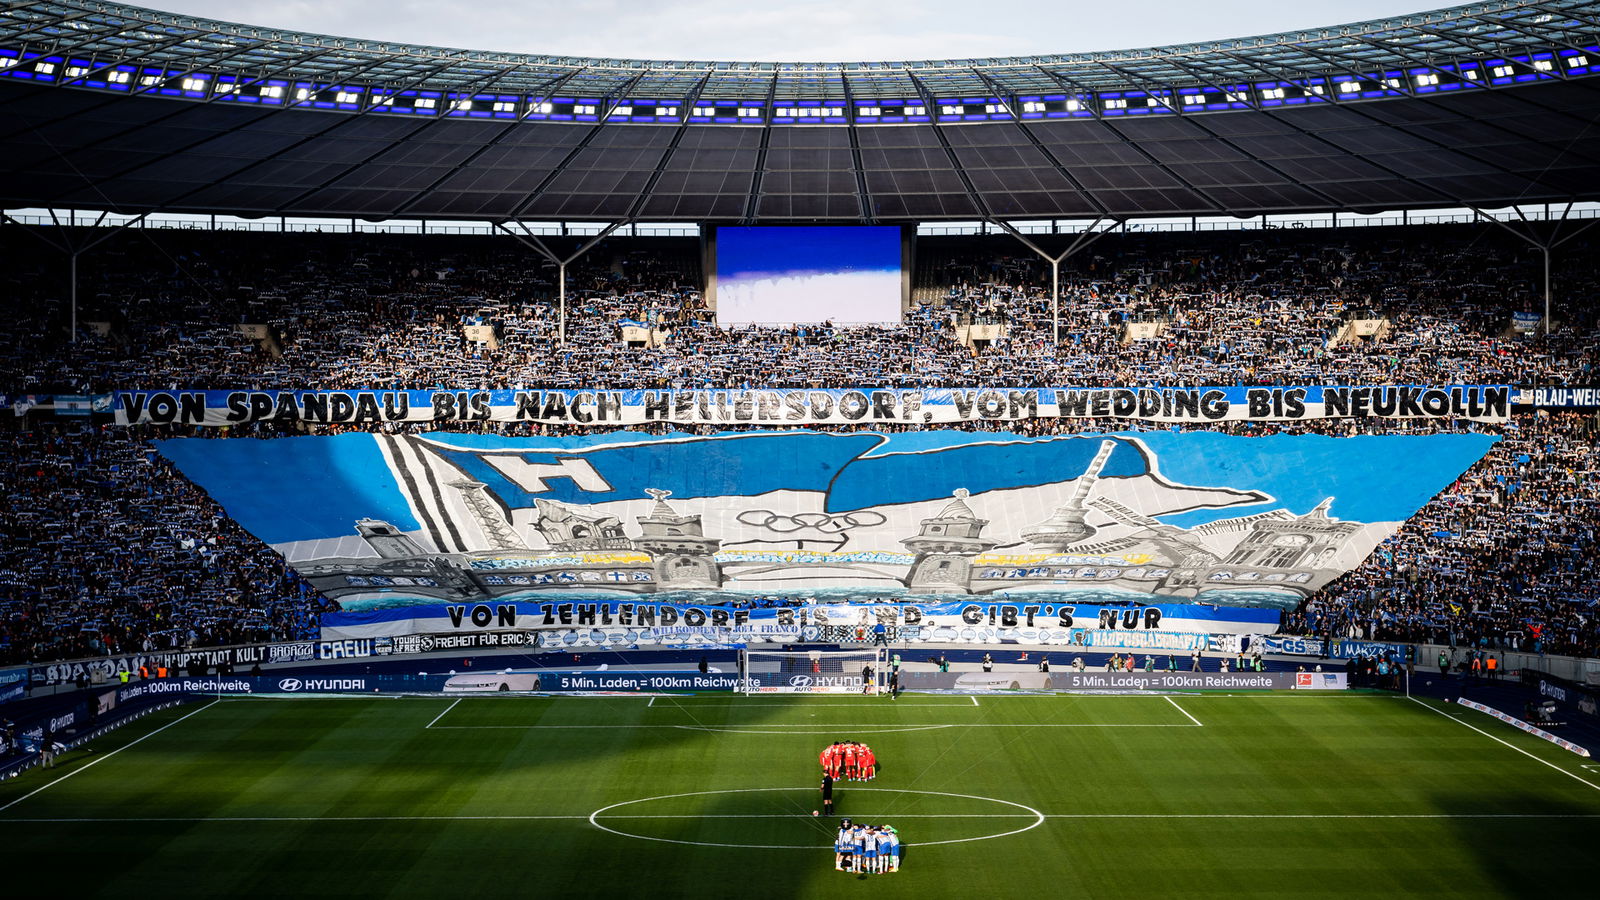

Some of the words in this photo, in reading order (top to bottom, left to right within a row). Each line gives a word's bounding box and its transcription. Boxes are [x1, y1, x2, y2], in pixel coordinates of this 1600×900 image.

[121, 392, 206, 424] VON
[226, 390, 409, 422] SPANDAU
[431, 391, 492, 421] BIS
[514, 391, 622, 422] NACH
[644, 391, 933, 423] HELLERSDORF,
[951, 390, 1038, 420] VOM
[1056, 389, 1230, 420] WEDDING
[1246, 388, 1309, 418] BIS
[1321, 384, 1508, 418] NEUKÖLLN
[479, 453, 617, 493] H
[447, 604, 516, 628] VON
[541, 604, 750, 627] ZEHLENDORF
[776, 607, 829, 626] BIS
[961, 605, 1075, 628] GIBT'S
[1098, 607, 1163, 629] NUR
[652, 626, 717, 636] WILLKOMMEN
[761, 624, 799, 634] FRANCO
[393, 636, 421, 645] YOUNG
[435, 635, 477, 648] FREIHEIT
[479, 633, 499, 645] FÜR
[501, 633, 524, 645] ERIC
[1282, 640, 1306, 653] GS
[236, 647, 266, 663] KULT
[320, 639, 371, 660] CREW
[148, 682, 181, 693] 100km
[183, 679, 250, 691] Reichweite
[305, 680, 365, 690] HYUNDAI
[561, 678, 569, 688] 5
[572, 677, 598, 688] Min.
[600, 677, 637, 688] Laden
[650, 677, 691, 688] 100km
[694, 677, 761, 688] Reichwte
[816, 677, 868, 687] HYUND
[1073, 677, 1080, 687] 5
[1082, 676, 1108, 687] Min.
[1111, 676, 1149, 687] Laden
[1161, 676, 1202, 687] 100km
[1205, 676, 1273, 687] Reichweite
